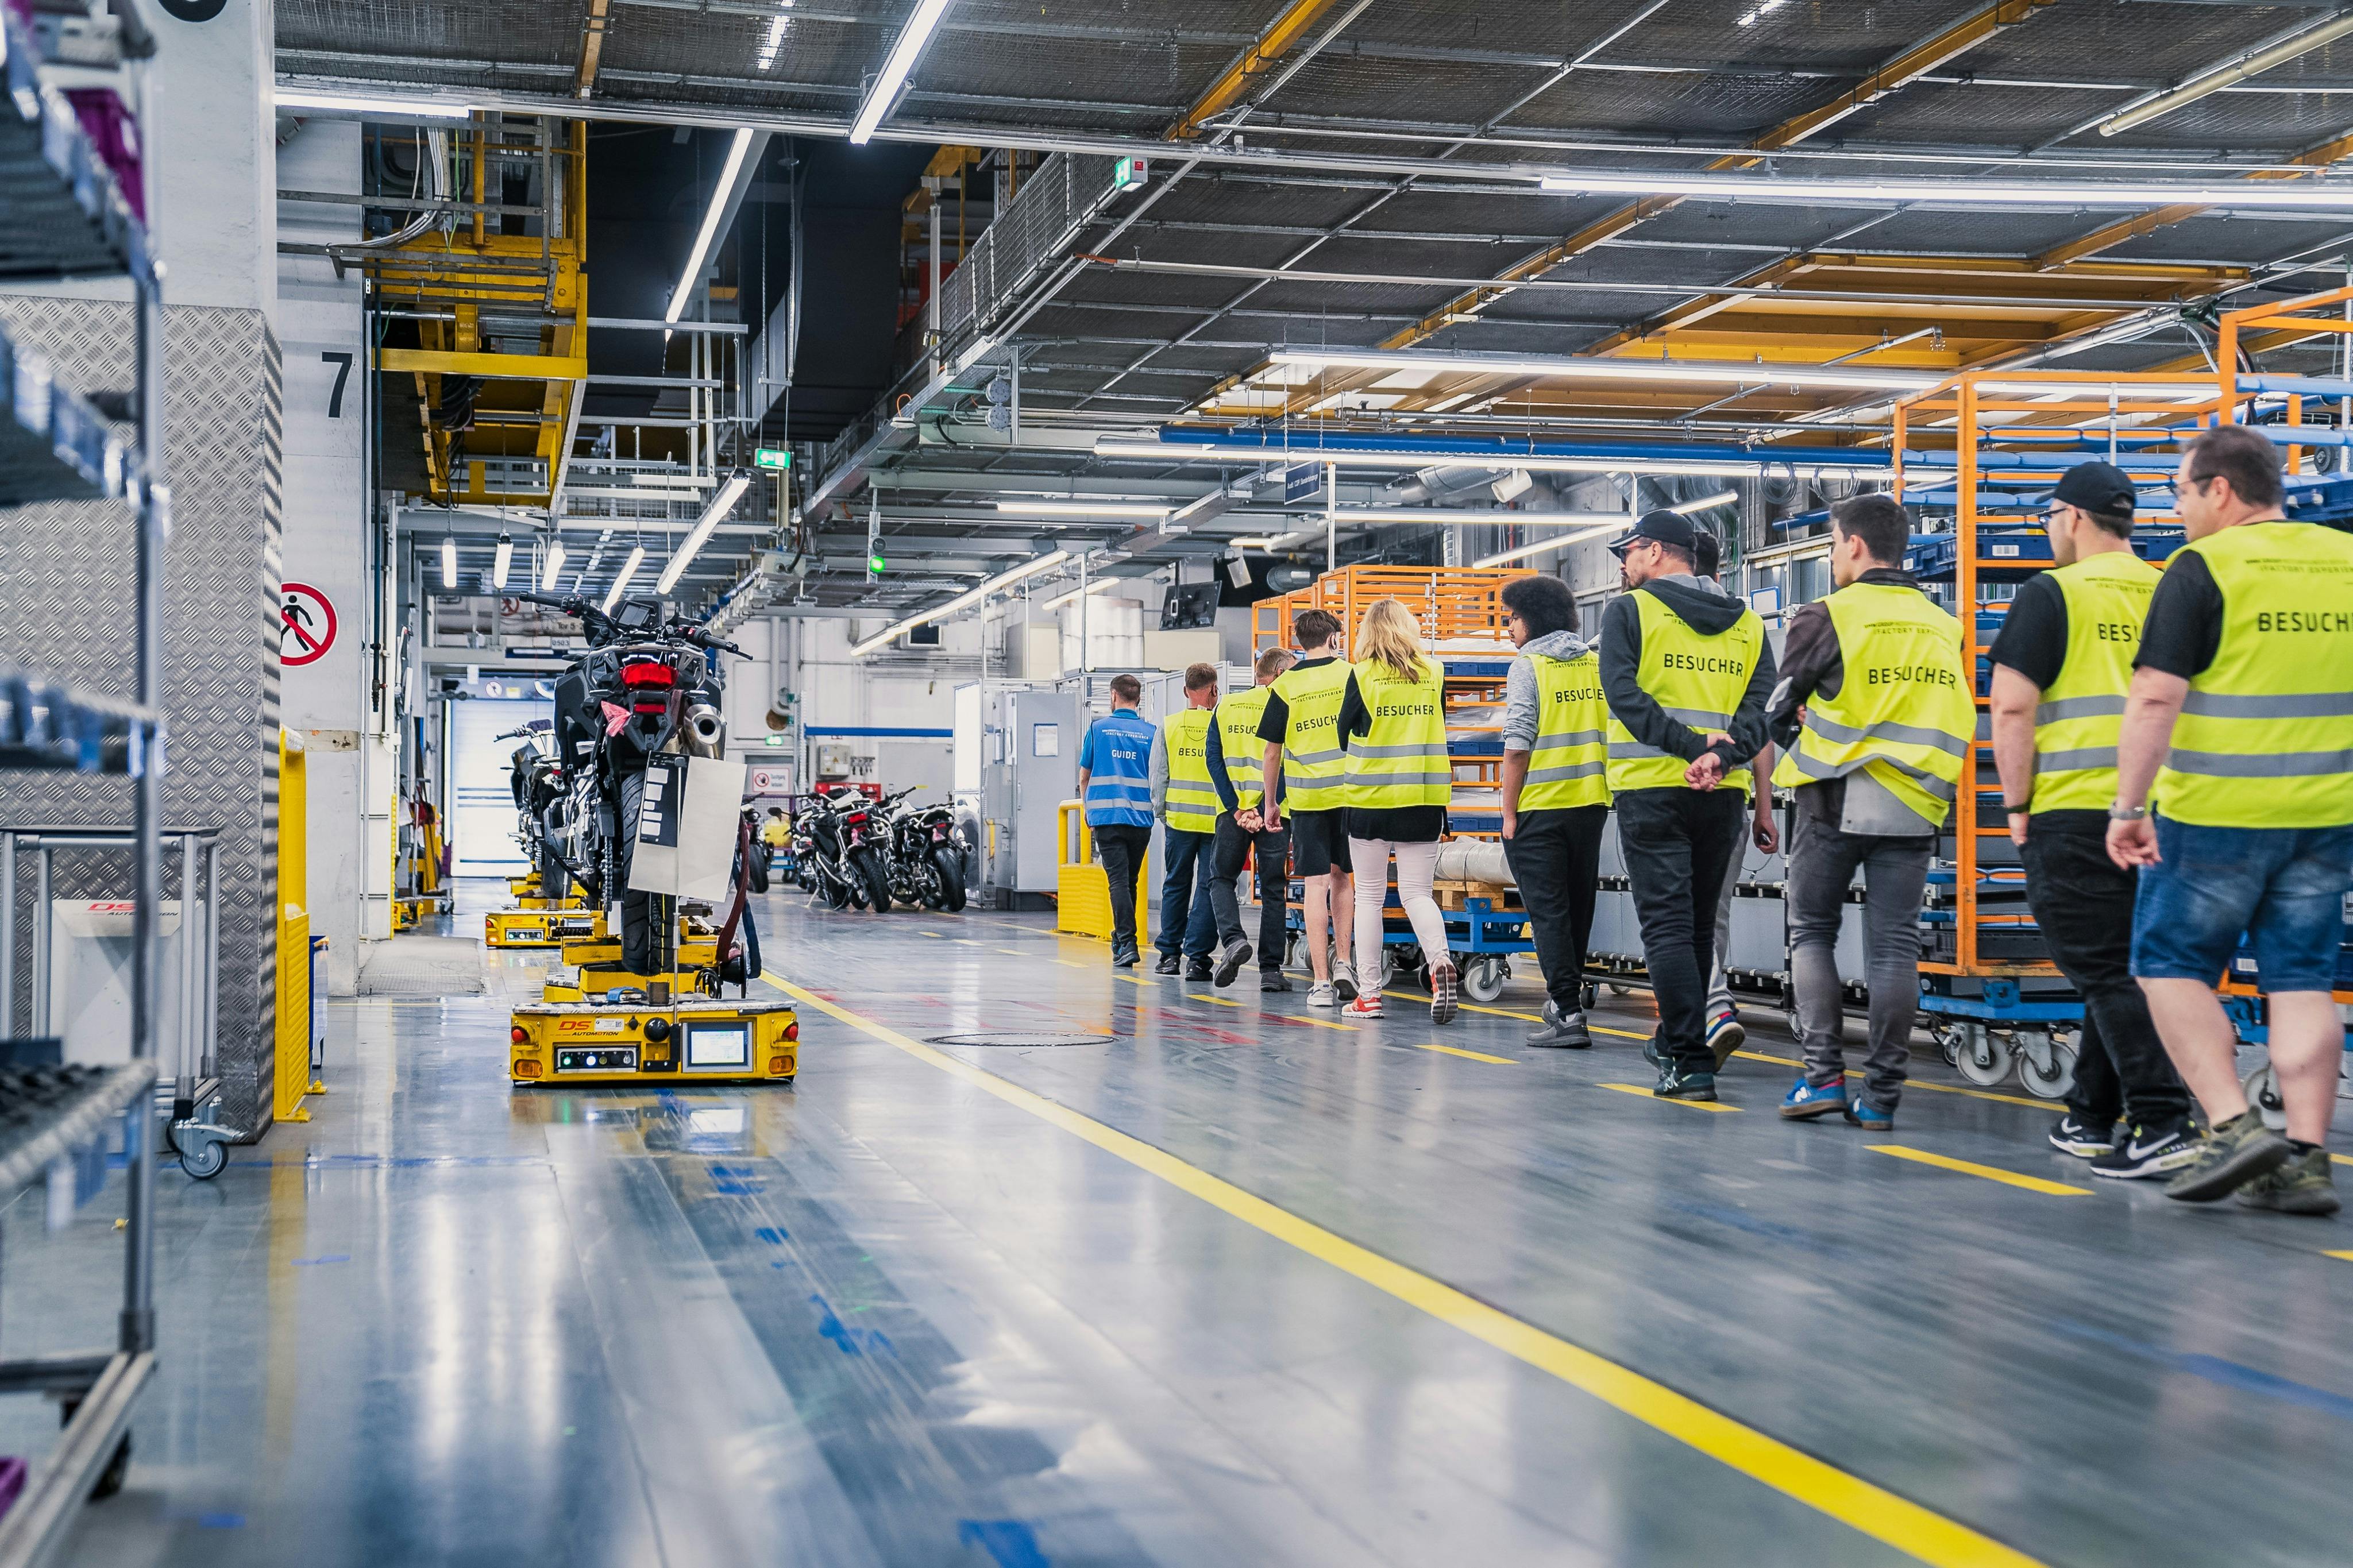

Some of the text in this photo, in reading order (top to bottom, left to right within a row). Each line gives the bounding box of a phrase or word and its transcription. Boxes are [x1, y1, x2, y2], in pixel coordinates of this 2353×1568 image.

[322, 351, 353, 418] 7
[2258, 612, 2353, 632] BESUCH
[1664, 653, 1743, 677] BESUCHER
[1869, 666, 1955, 690] BESUCHER
[1376, 705, 1434, 717] BESUCHER
[1228, 724, 1257, 734] BESUC
[1295, 715, 1337, 732] BESUCH
[1112, 749, 1137, 760] GUIDE
[1178, 747, 1203, 757] BESU
[558, 1021, 592, 1030] DS
